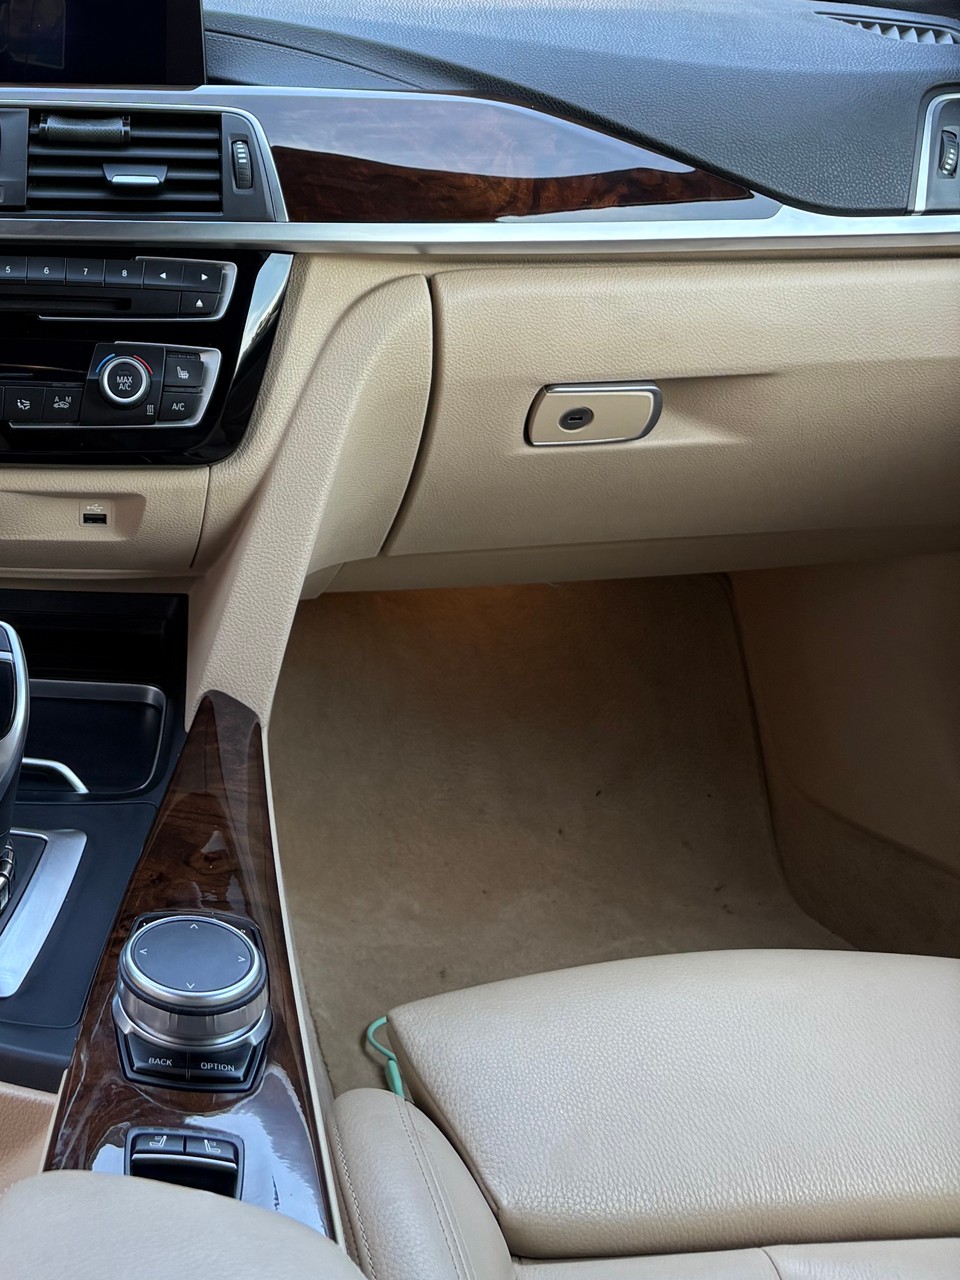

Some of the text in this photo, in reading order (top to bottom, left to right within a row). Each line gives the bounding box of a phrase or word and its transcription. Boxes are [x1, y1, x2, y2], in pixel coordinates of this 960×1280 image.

[121, 269, 128, 277] 8
[171, 403, 185, 411] A/C
[148, 1057, 173, 1067] BACK
[200, 1061, 235, 1072] OPTION
